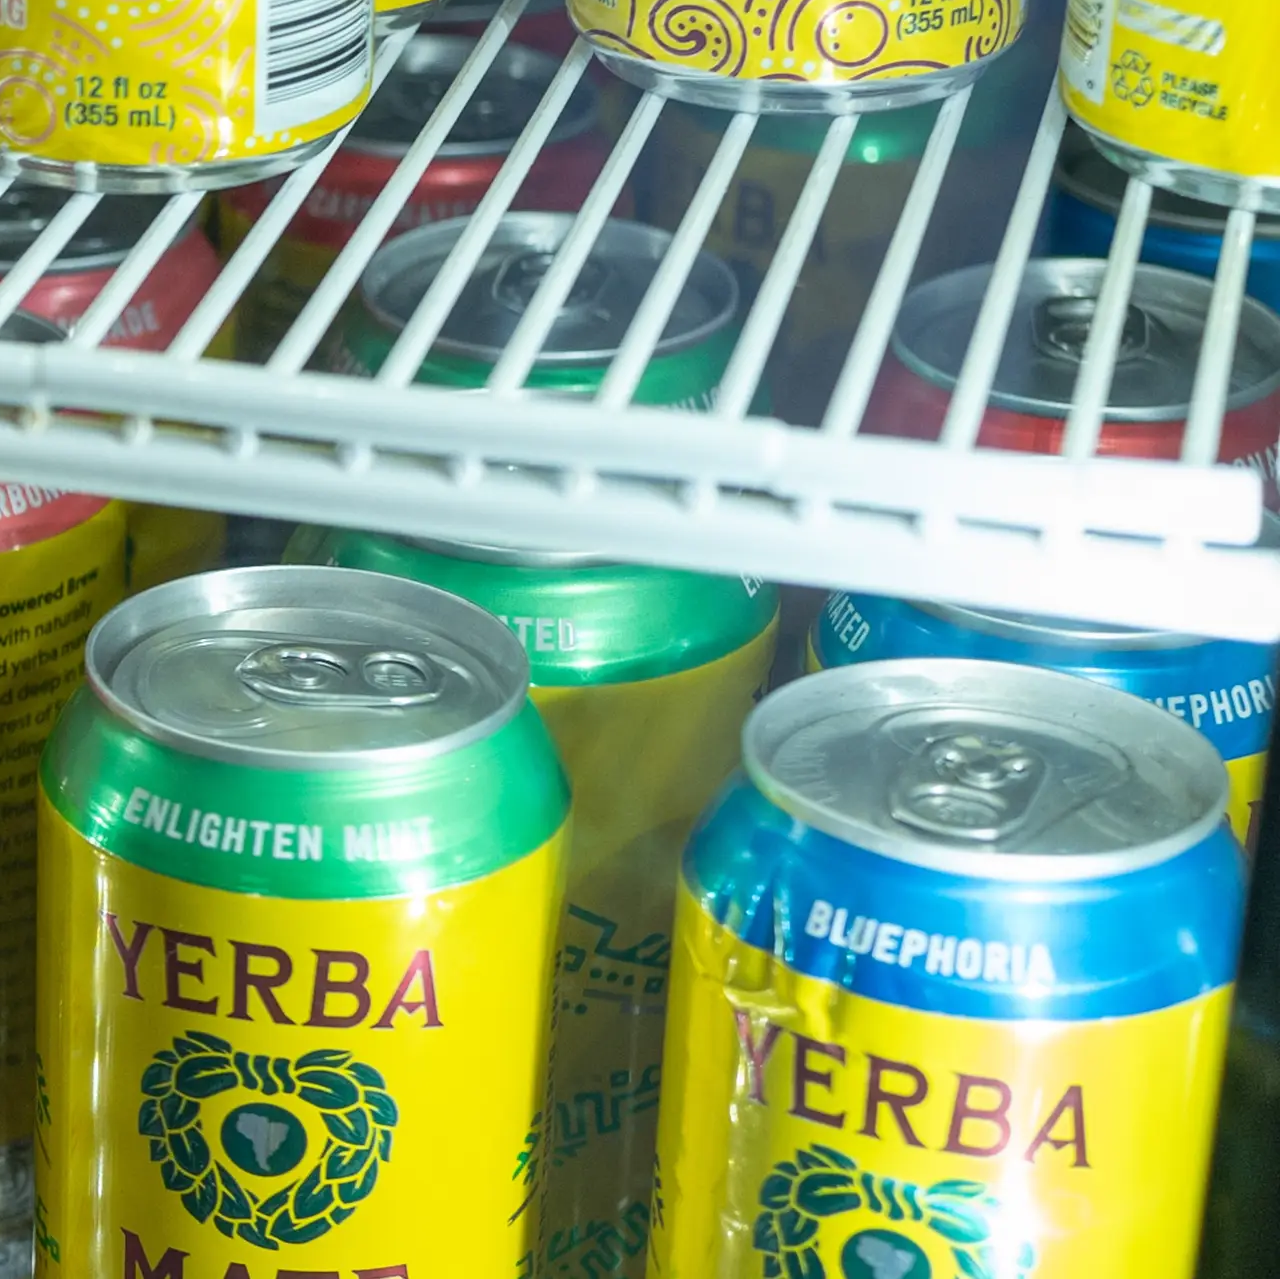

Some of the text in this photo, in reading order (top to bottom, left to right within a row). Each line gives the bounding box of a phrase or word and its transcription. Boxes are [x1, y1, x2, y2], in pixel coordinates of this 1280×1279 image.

[895, 11, 946, 41] (355
[73, 75, 167, 100] 12 fl oz
[64, 101, 177, 131] (355 mL)
[66, 568, 100, 595] Brew
[34, 601, 94, 640] naturally
[9, 648, 60, 677] yerba
[122, 785, 434, 864] ENLIGHTEN MINT
[804, 898, 1057, 987] BLUEPHORIA
[100, 911, 445, 1031] YERBA
[734, 1006, 1092, 1170] YERBA
